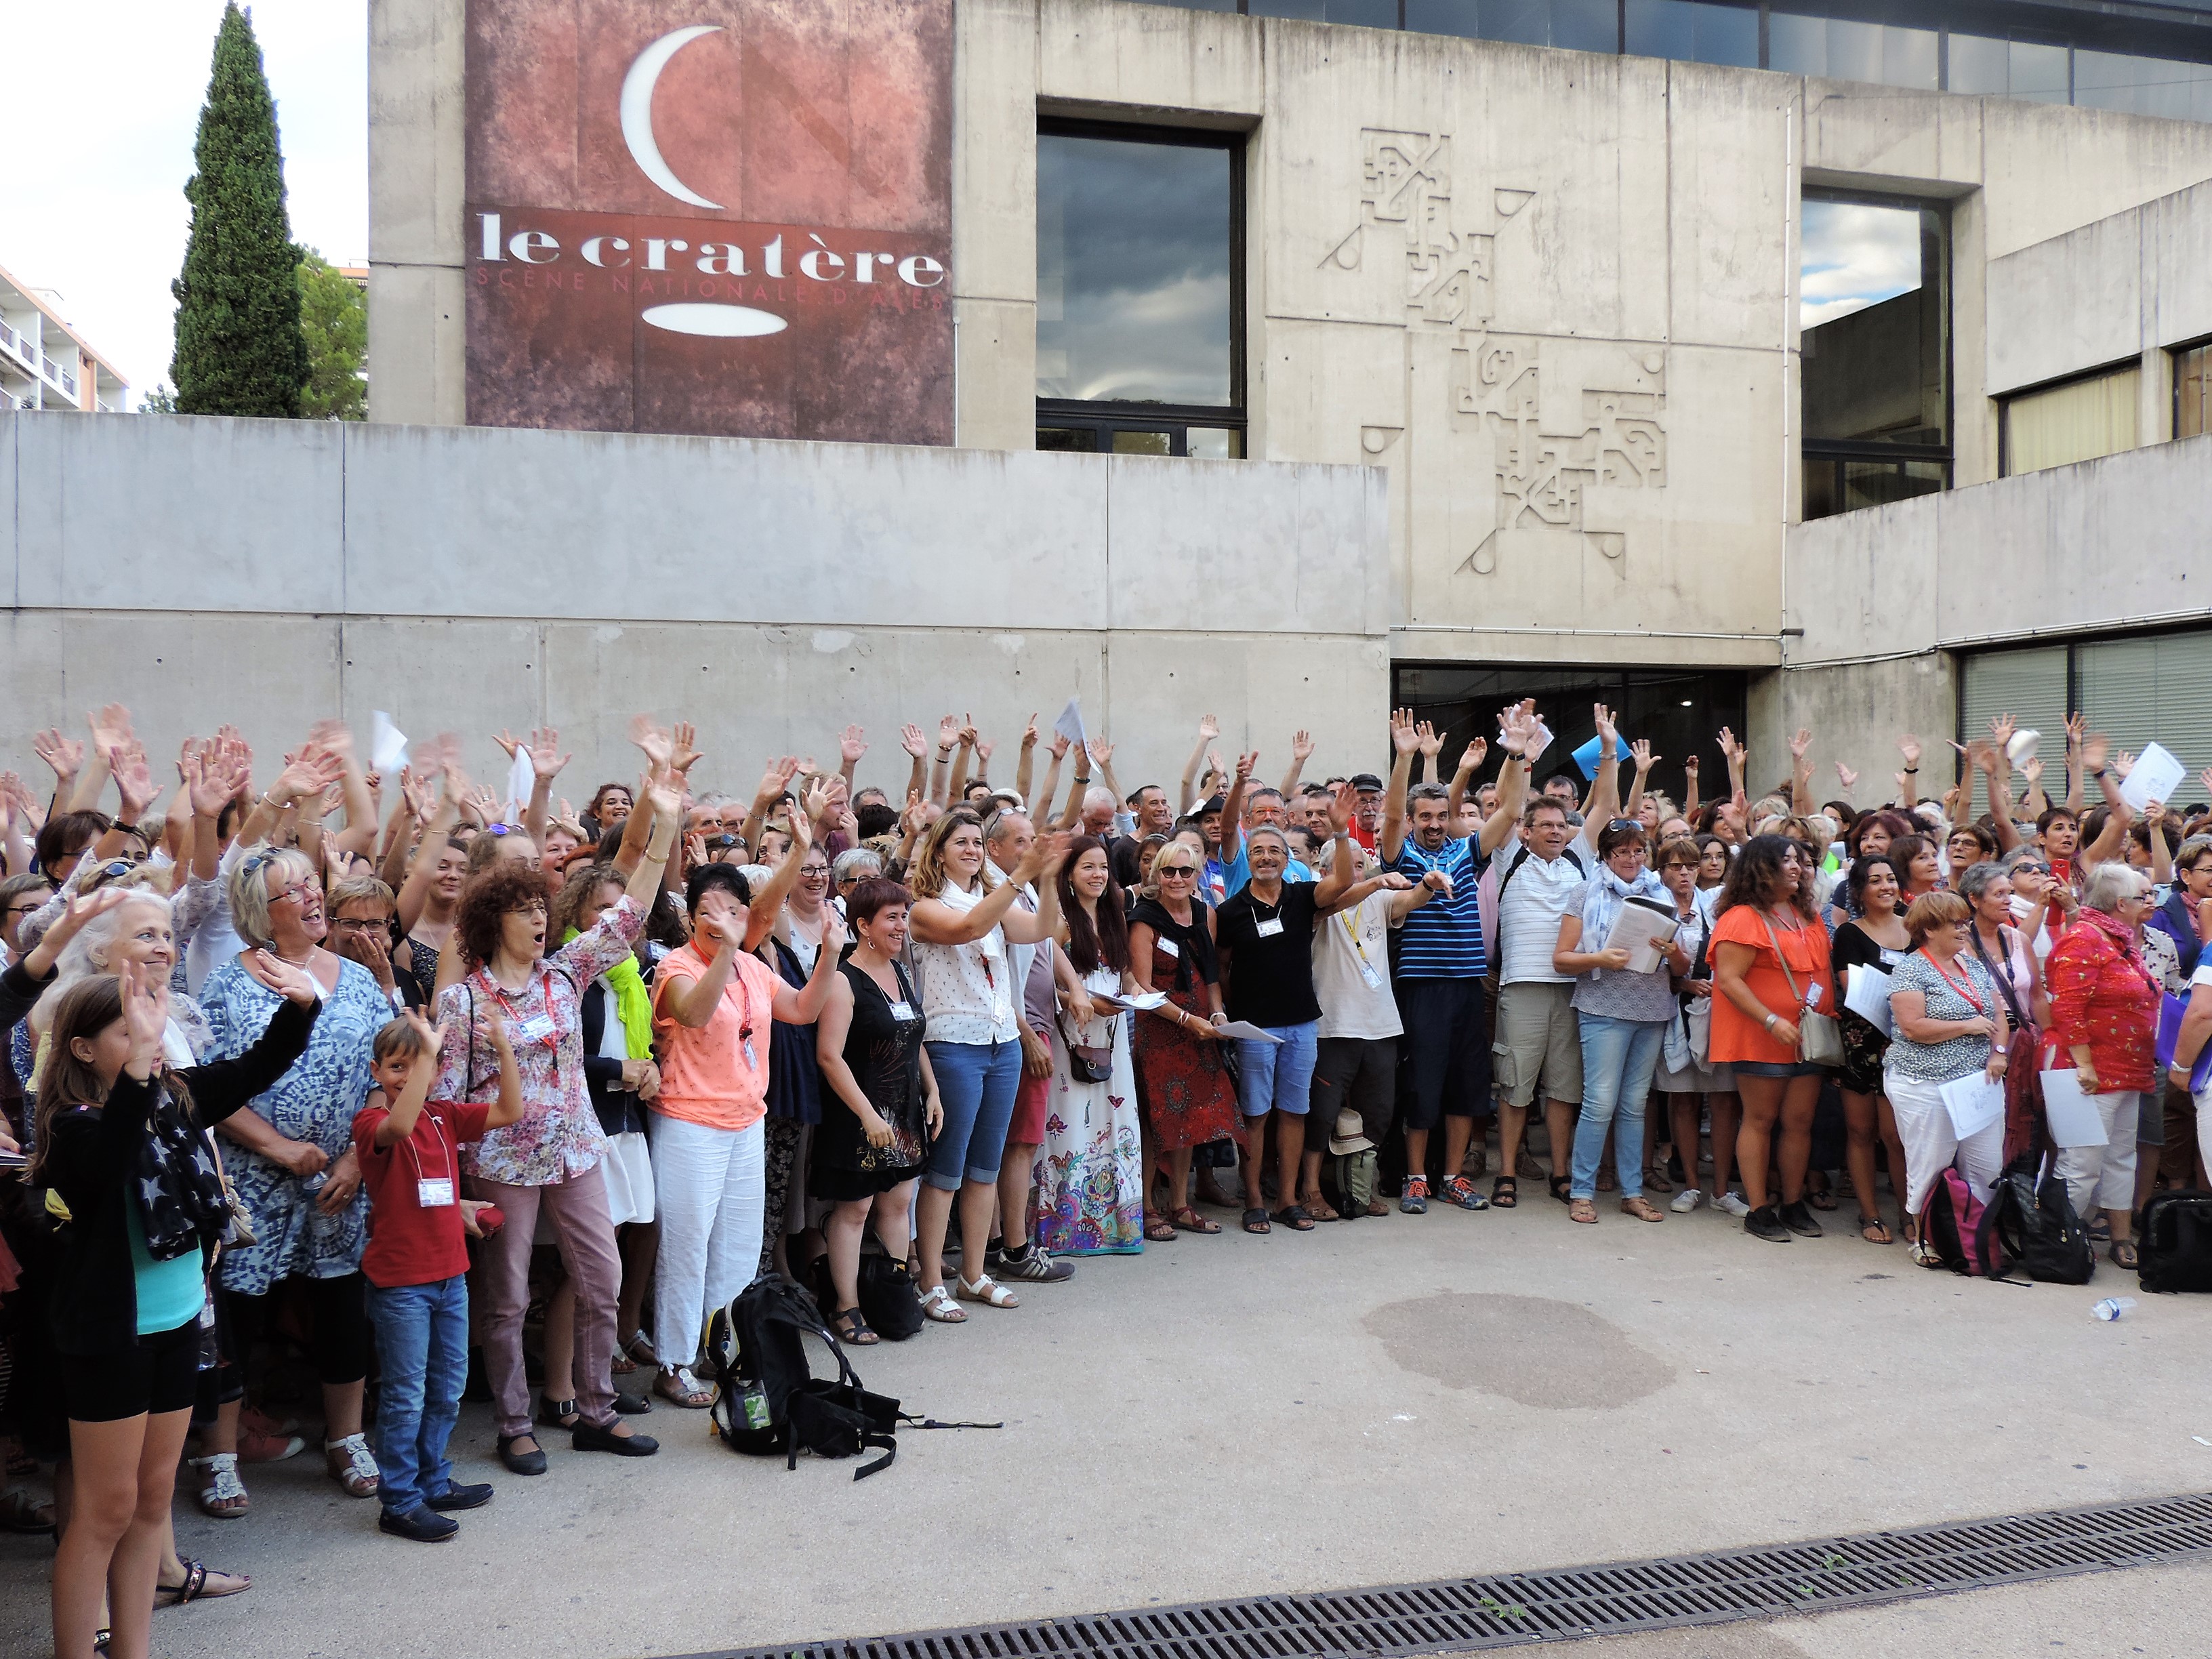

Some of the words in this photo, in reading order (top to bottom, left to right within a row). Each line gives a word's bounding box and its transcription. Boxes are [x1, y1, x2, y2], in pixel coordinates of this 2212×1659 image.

[476, 212, 561, 264] le
[580, 233, 944, 287] cratère
[476, 265, 584, 291] SCÈNE
[613, 274, 806, 303] NATIONALE
